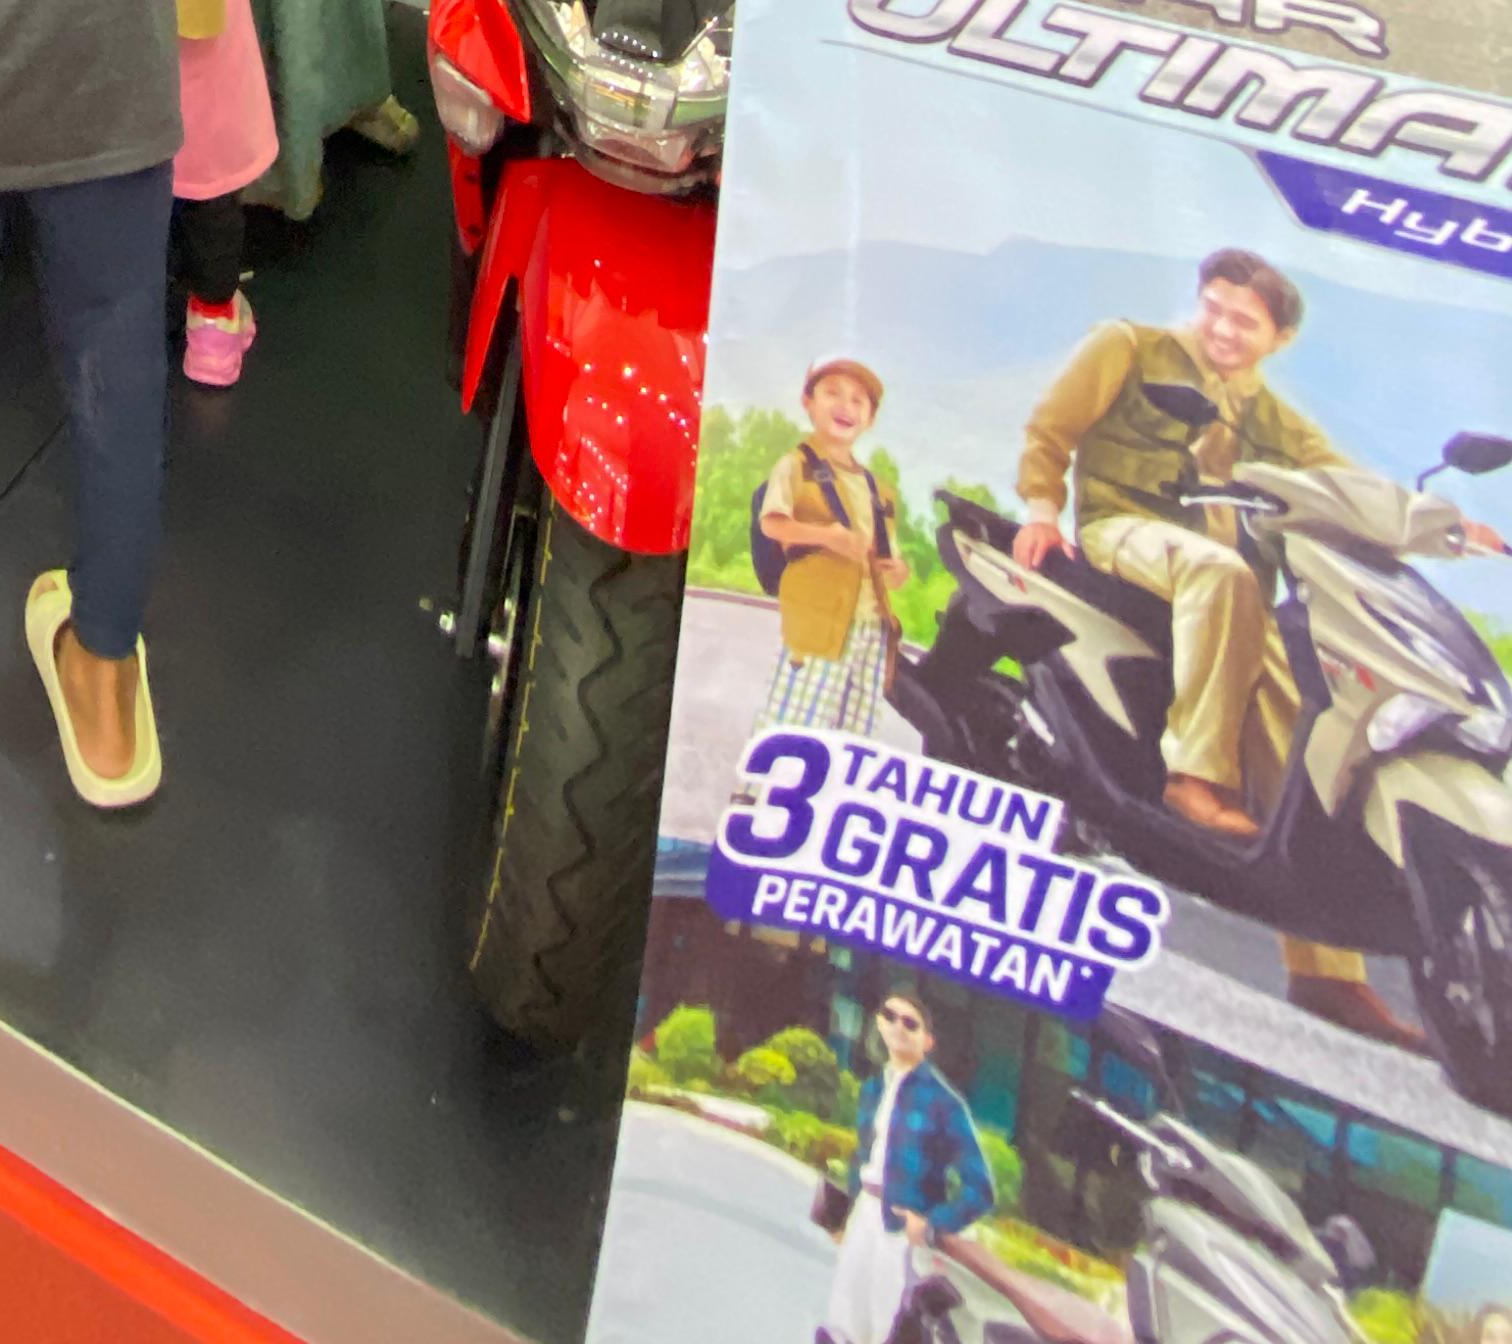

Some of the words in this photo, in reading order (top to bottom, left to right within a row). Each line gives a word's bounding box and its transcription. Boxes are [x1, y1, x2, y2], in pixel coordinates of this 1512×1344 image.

[725, 733, 830, 858] 3
[843, 744, 1051, 841] TAHUN
[821, 802, 1162, 961] GRATIS
